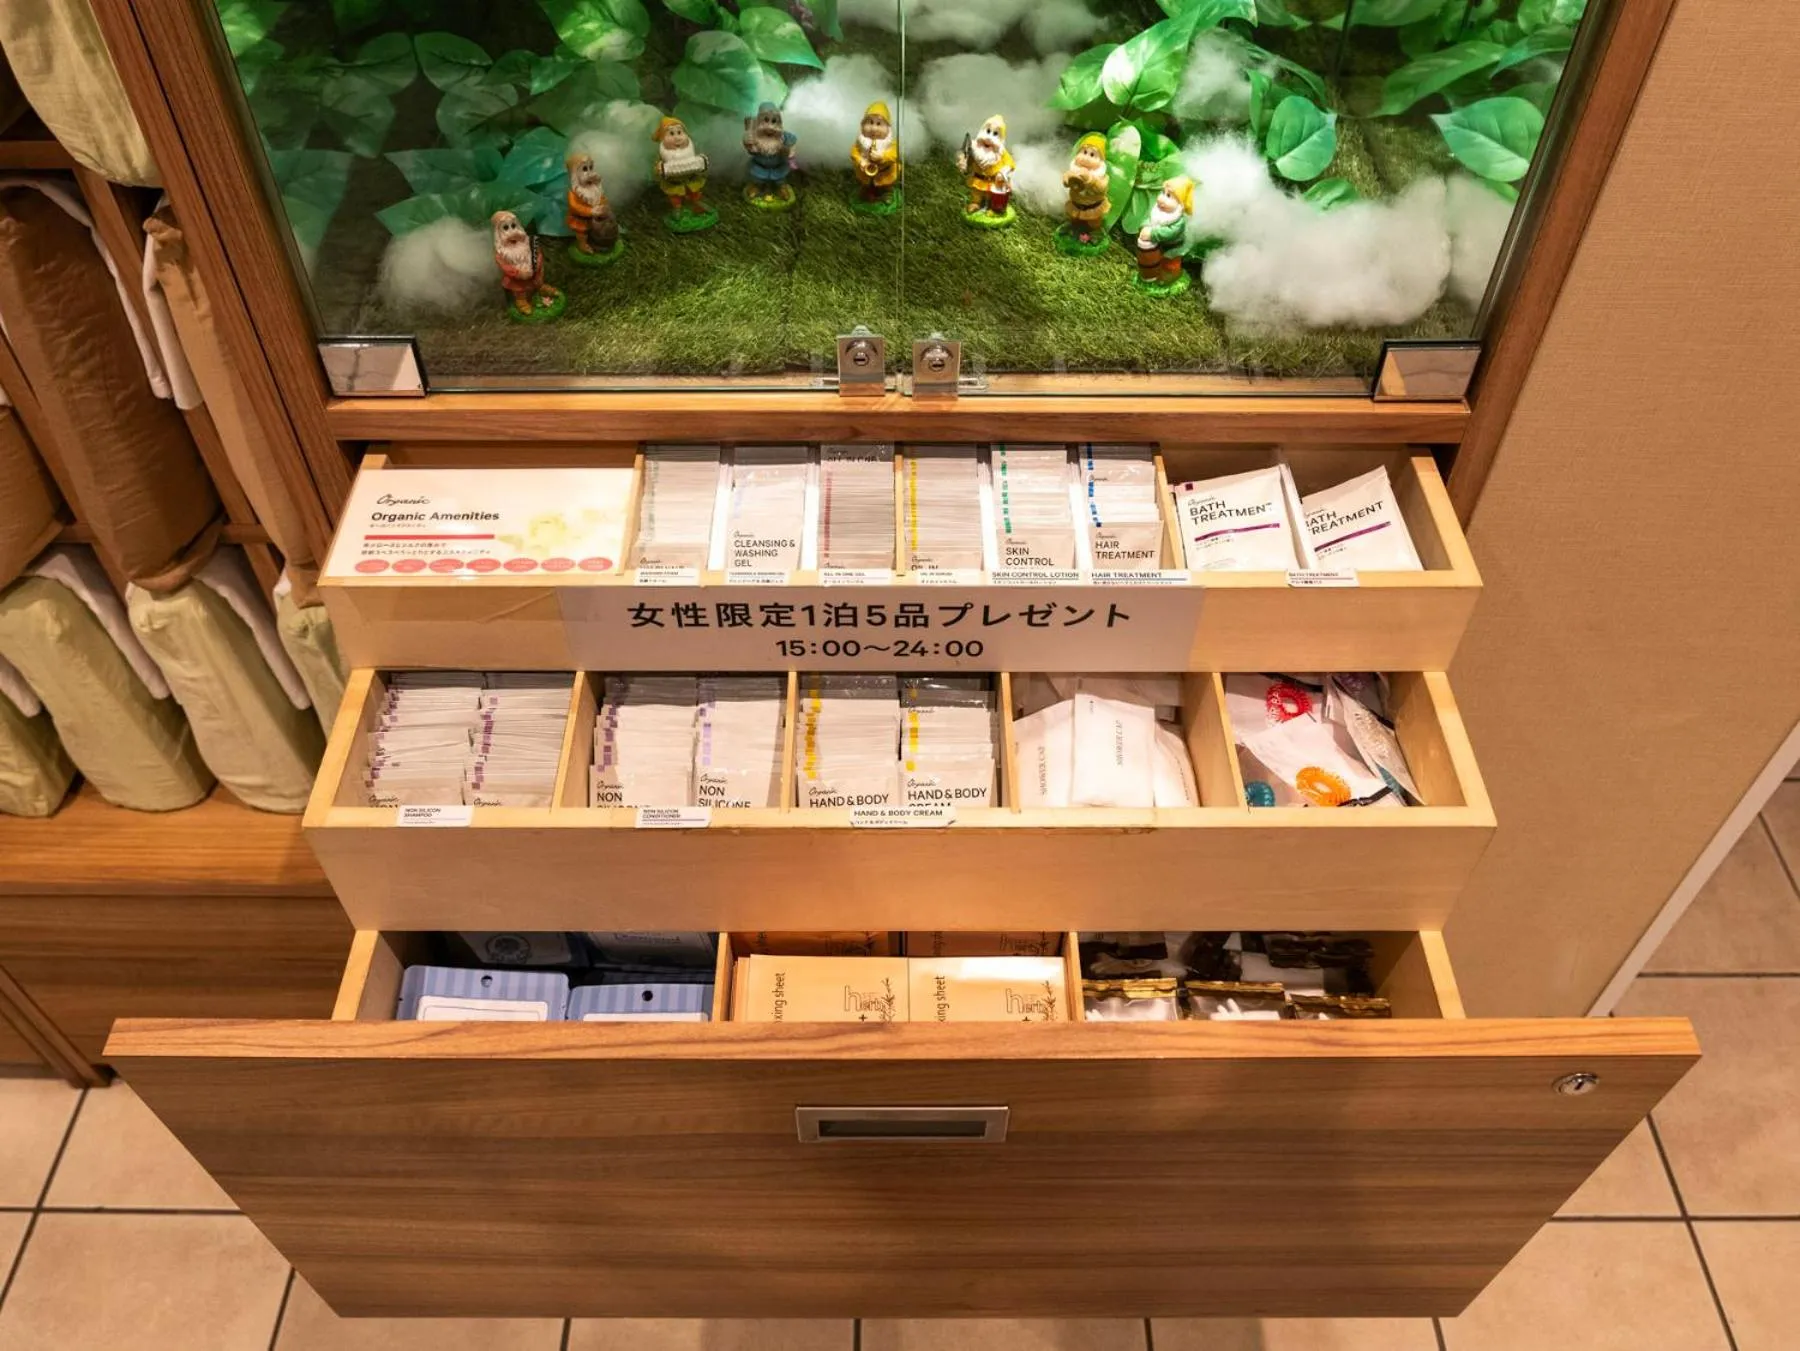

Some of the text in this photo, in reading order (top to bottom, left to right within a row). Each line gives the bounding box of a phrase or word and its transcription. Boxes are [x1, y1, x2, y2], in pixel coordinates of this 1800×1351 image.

[1190, 500, 1226, 516] BATH
[371, 511, 500, 522] Organic Amenities
[1308, 500, 1383, 535] REATMENT
[734, 540, 795, 548] CLEANSING &
[1095, 541, 1119, 549] HAIR
[735, 549, 778, 557] WASHING
[1005, 547, 1030, 556] SKIN
[1096, 551, 1155, 560] TREATMENT
[735, 559, 752, 567] GEL
[1005, 558, 1054, 566] CONTROL
[627, 602, 1131, 628] 女性限定1泊5品プレゼント
[699, 785, 725, 796] NON
[907, 787, 987, 800] HAND & BODY
[597, 792, 623, 802] NON
[809, 794, 889, 808] HAND & BODY
[771, 972, 786, 998] sheet
[933, 976, 946, 1001] sheet
